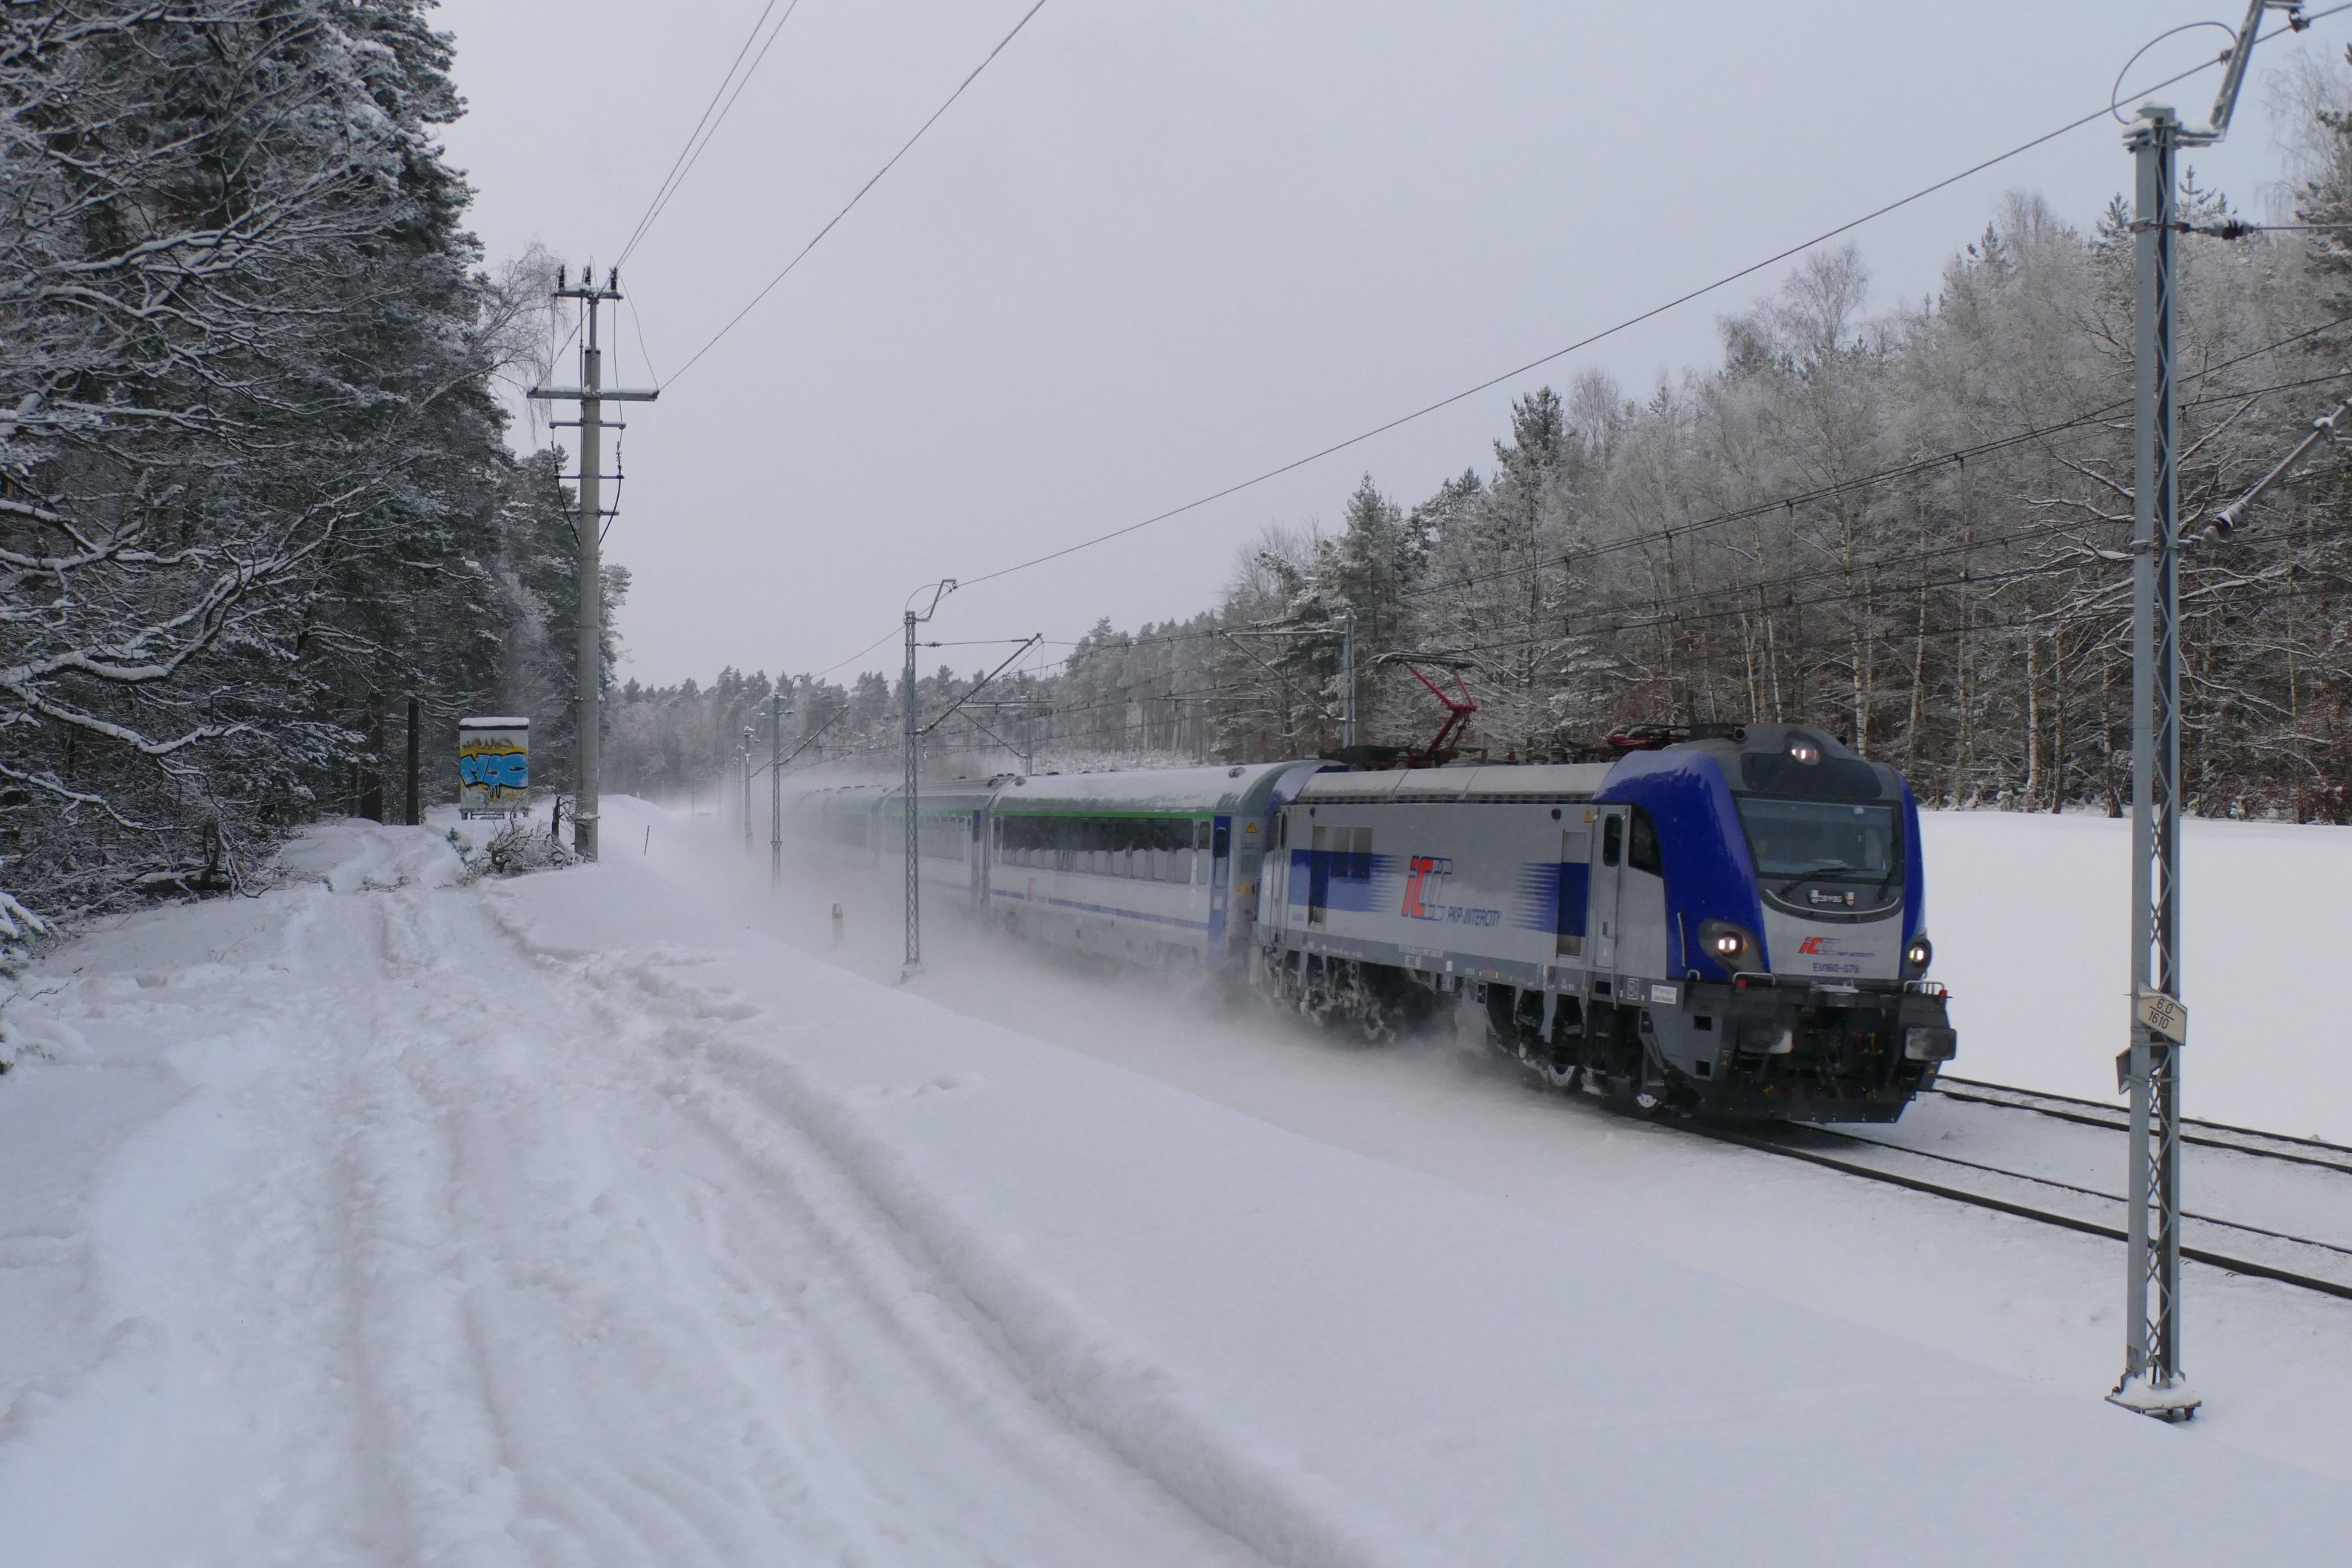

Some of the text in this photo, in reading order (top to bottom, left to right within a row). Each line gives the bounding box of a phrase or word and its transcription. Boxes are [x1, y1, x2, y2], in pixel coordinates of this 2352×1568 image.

[1446, 906, 1502, 928] PKP INTERCITY
[2147, 1010, 2170, 1030] 1610
